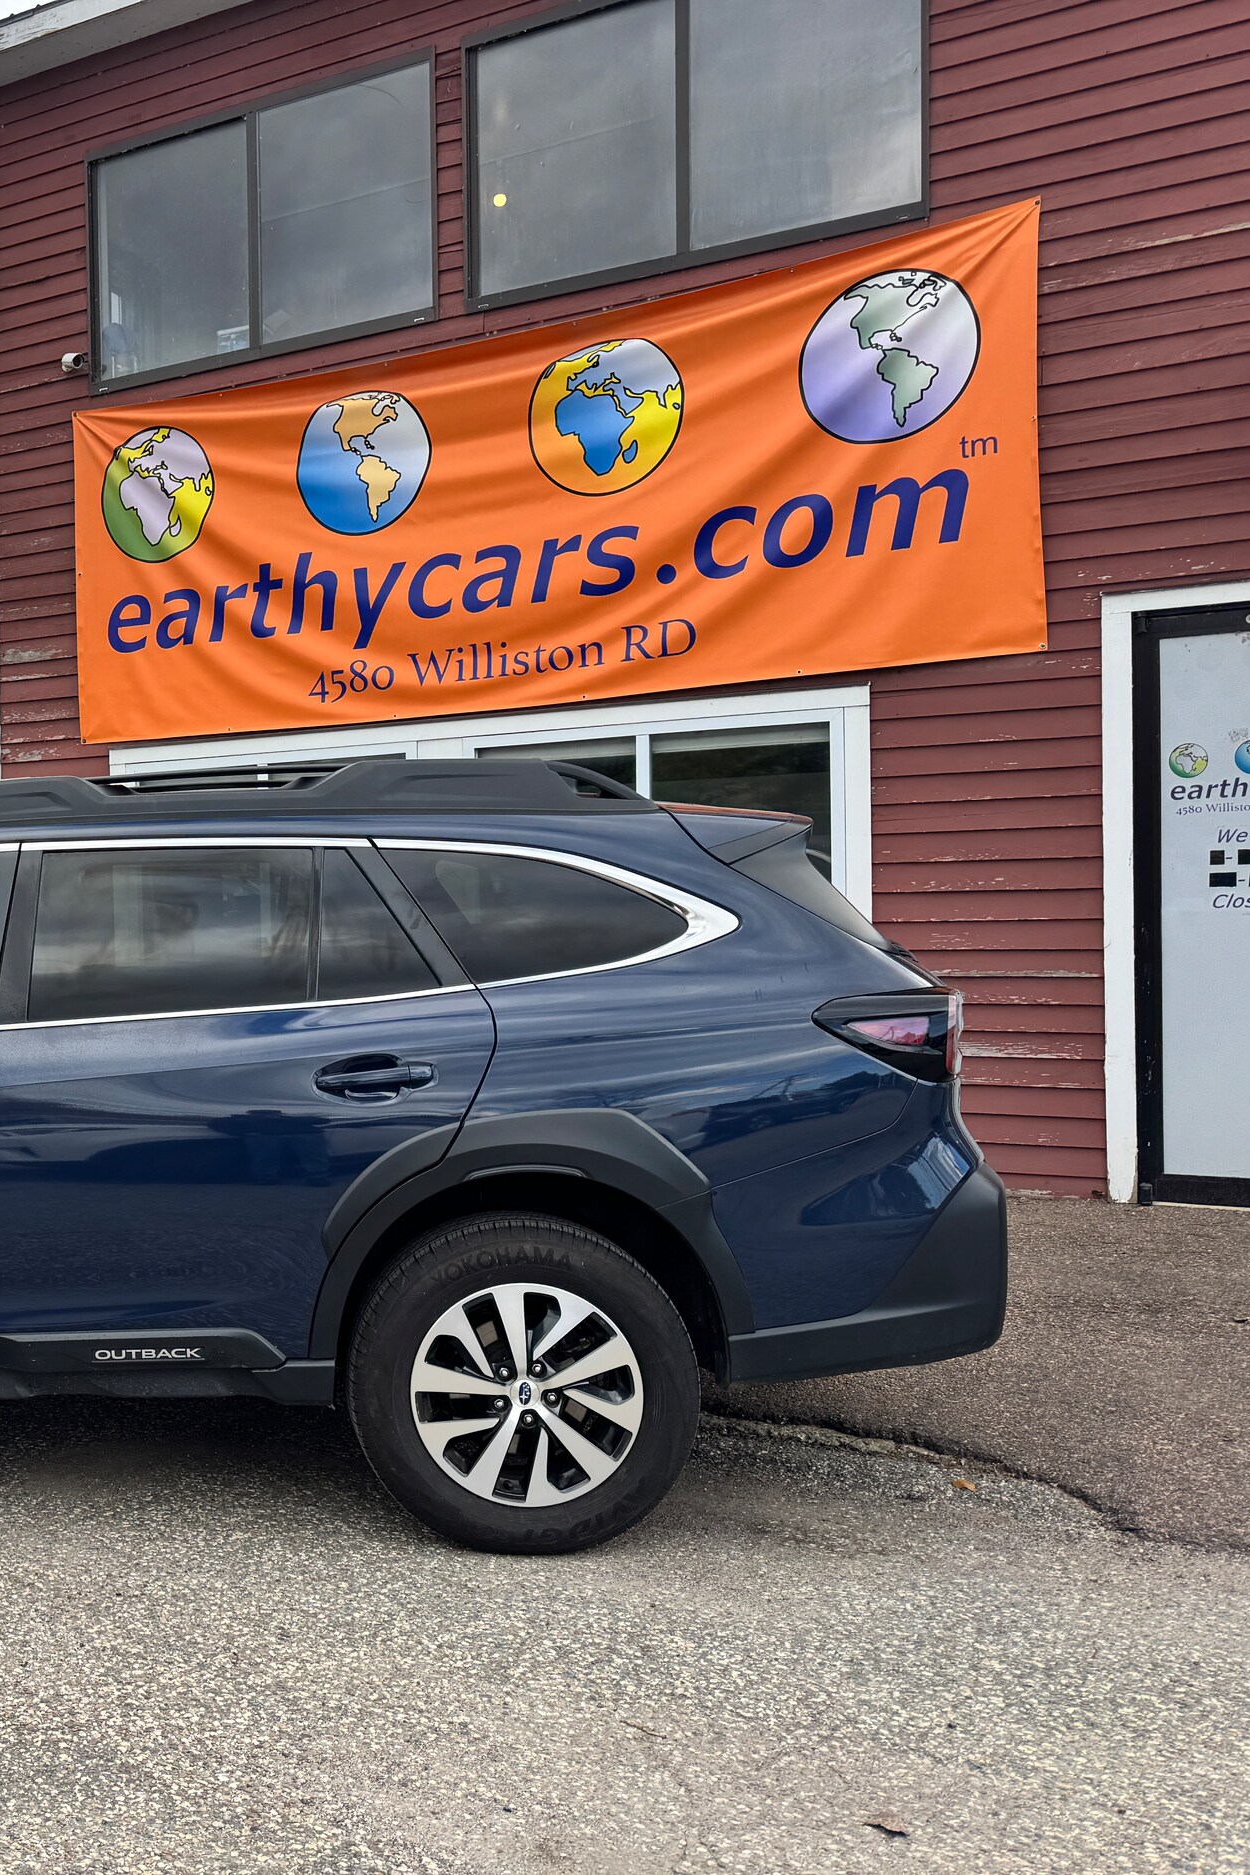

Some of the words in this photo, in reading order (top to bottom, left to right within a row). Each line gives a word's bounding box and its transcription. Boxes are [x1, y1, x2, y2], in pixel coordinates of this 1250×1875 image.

[958, 434, 999, 459] tm
[106, 468, 970, 651] earthycars.com
[307, 661, 396, 704] 4580
[407, 640, 606, 688] Williston
[619, 617, 698, 663] RD
[1170, 776, 1249, 801] earth
[1175, 804, 1203, 816] 4580
[1217, 828, 1249, 844] We
[431, 1245, 573, 1287] YOKOHAMA
[94, 1347, 202, 1360] OUTBACK
